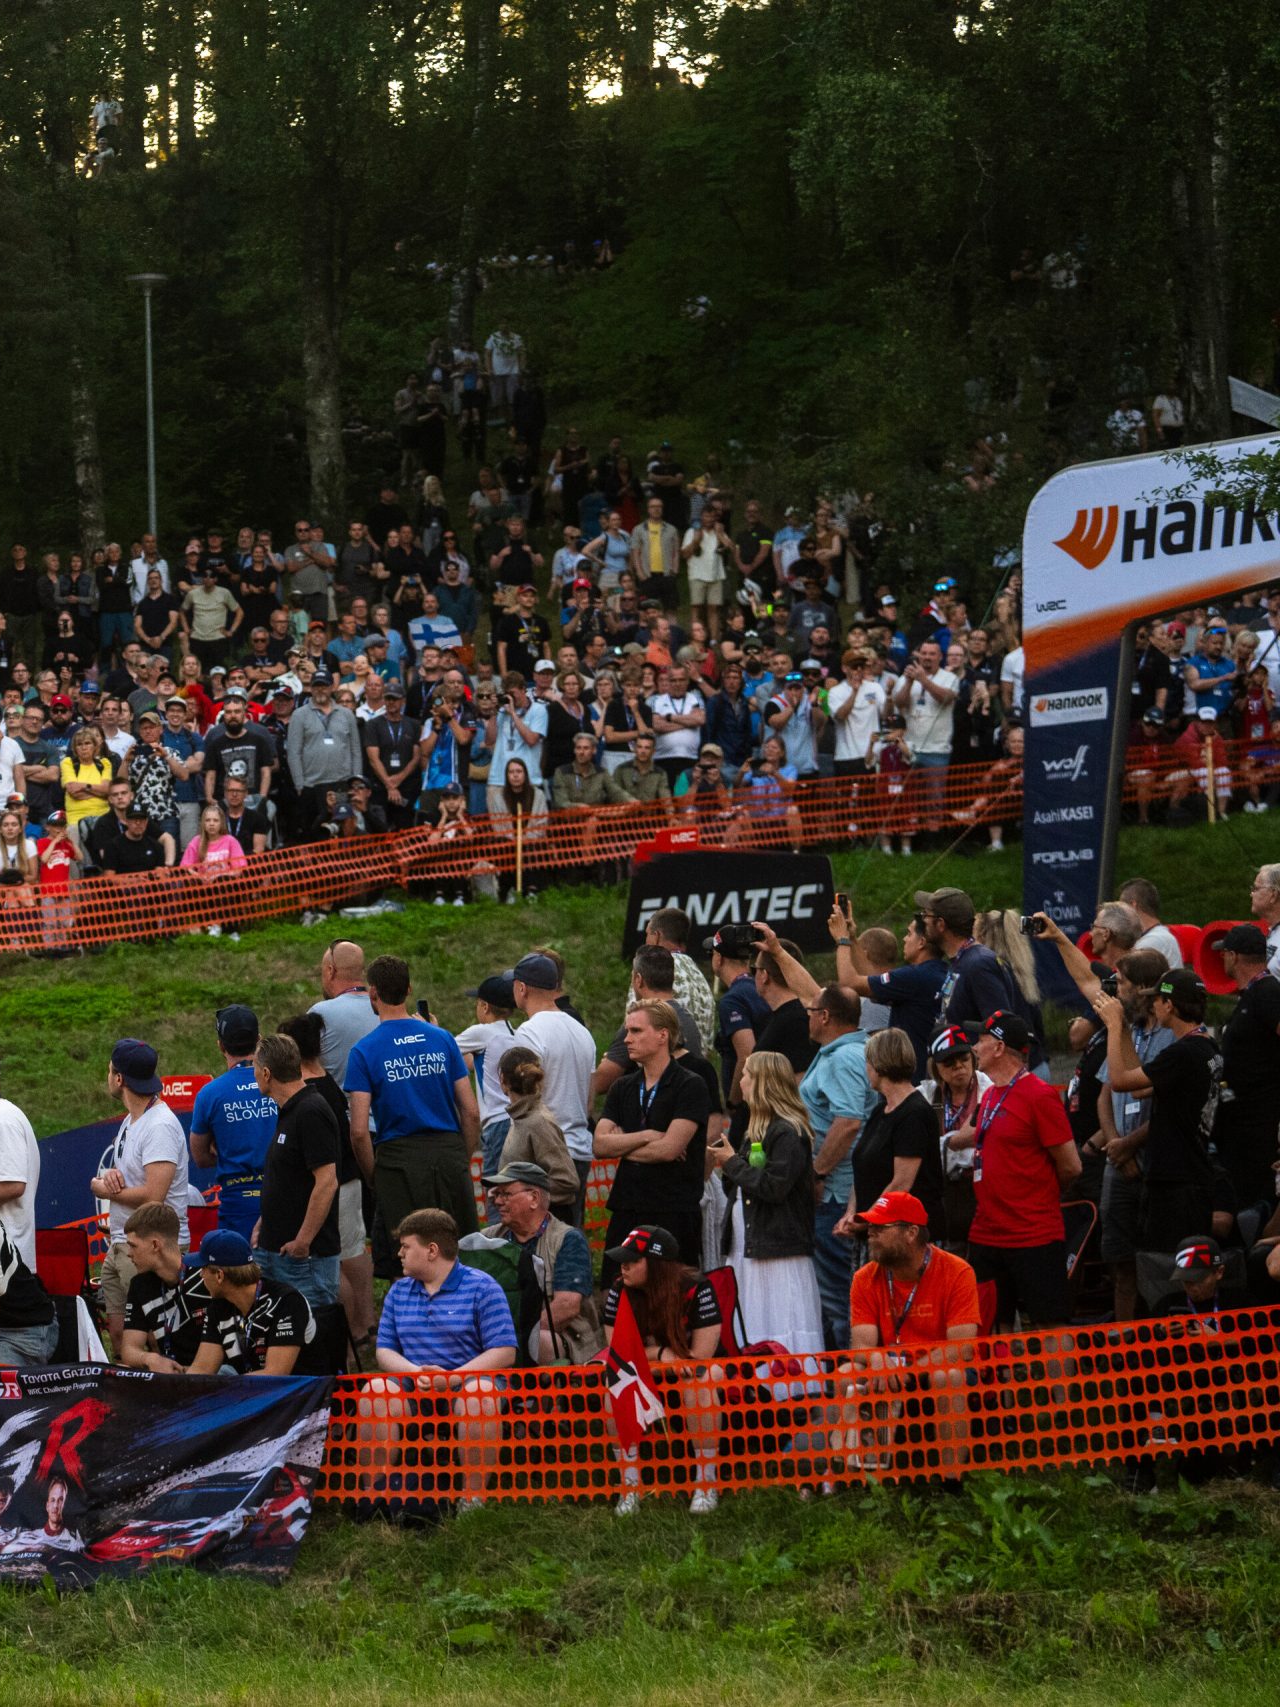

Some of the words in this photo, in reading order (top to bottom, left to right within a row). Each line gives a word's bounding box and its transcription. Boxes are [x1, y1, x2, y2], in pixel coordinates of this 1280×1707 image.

[1121, 495, 1280, 563] Hank
[1036, 599, 1067, 613] WRC
[670, 831, 697, 843] WRC
[393, 1034, 426, 1045] WRC
[384, 1055, 418, 1072] RALLY
[419, 1052, 446, 1066] FANS
[387, 1062, 447, 1082] SLOVENIA
[161, 1082, 193, 1096] WRC
[236, 1082, 259, 1091] WR
[223, 1099, 259, 1114] RALLY
[261, 1096, 277, 1108] FA
[226, 1106, 278, 1123] SLOVEN
[21, 1373, 61, 1385] TOYOTA
[62, 1367, 102, 1381] GAZOO
[43, 1385, 72, 1395] Challenge
